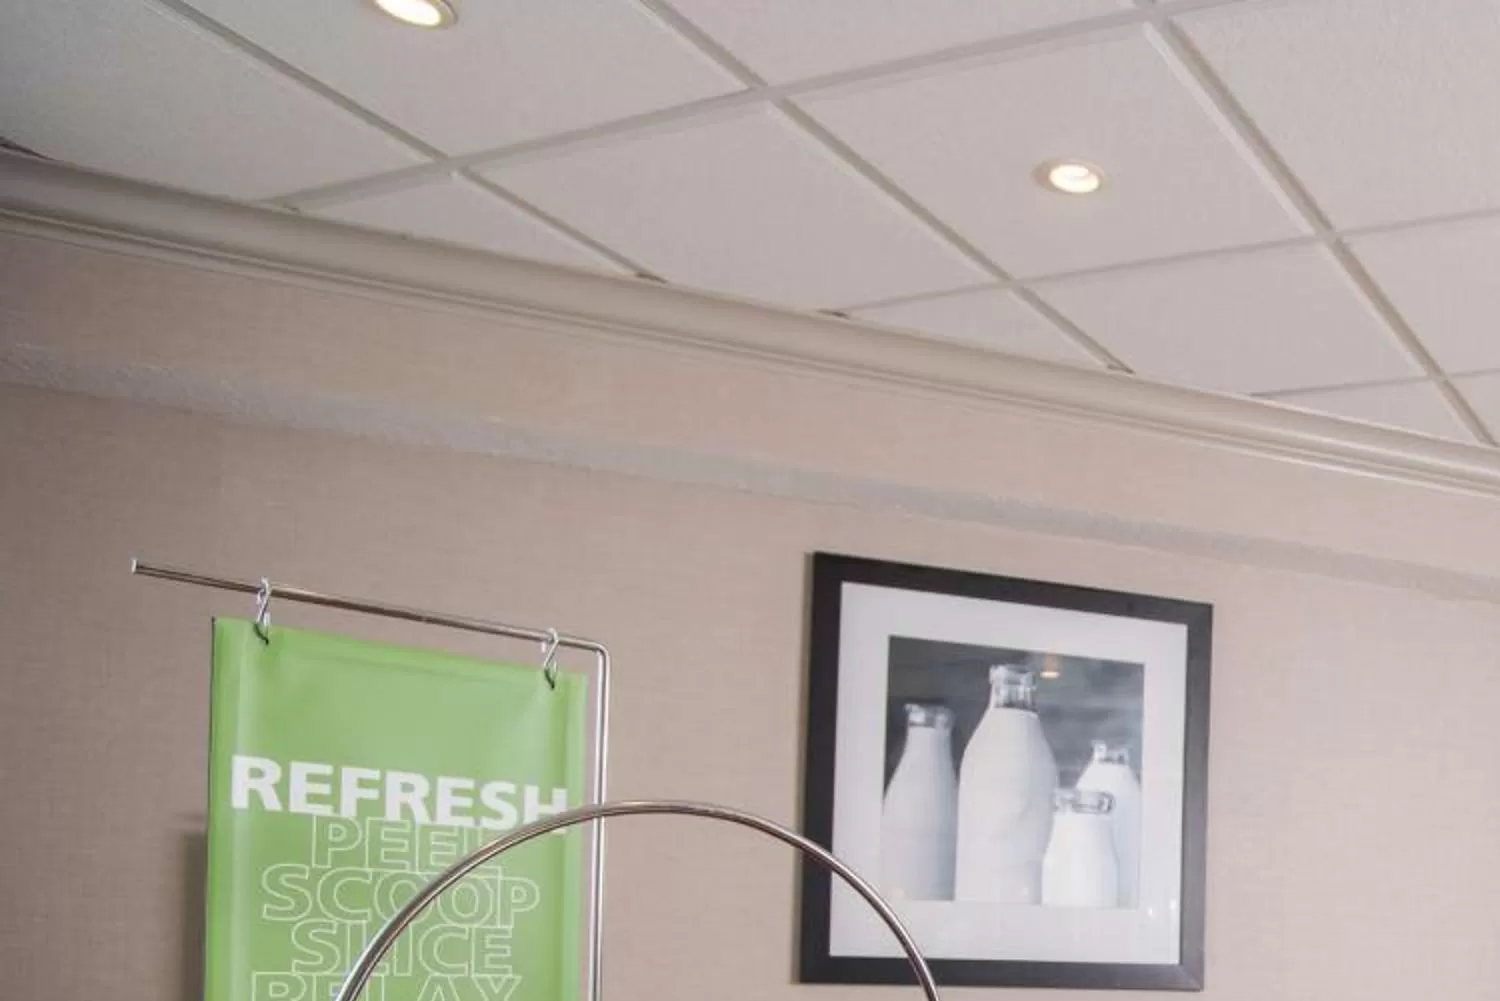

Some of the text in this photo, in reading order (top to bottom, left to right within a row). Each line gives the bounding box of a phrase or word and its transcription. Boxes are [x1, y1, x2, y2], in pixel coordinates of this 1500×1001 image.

[230, 754, 568, 835] REFRESH
[312, 815, 501, 879] PEEL
[261, 864, 541, 928] SCOOP
[291, 918, 513, 977] SLICE
